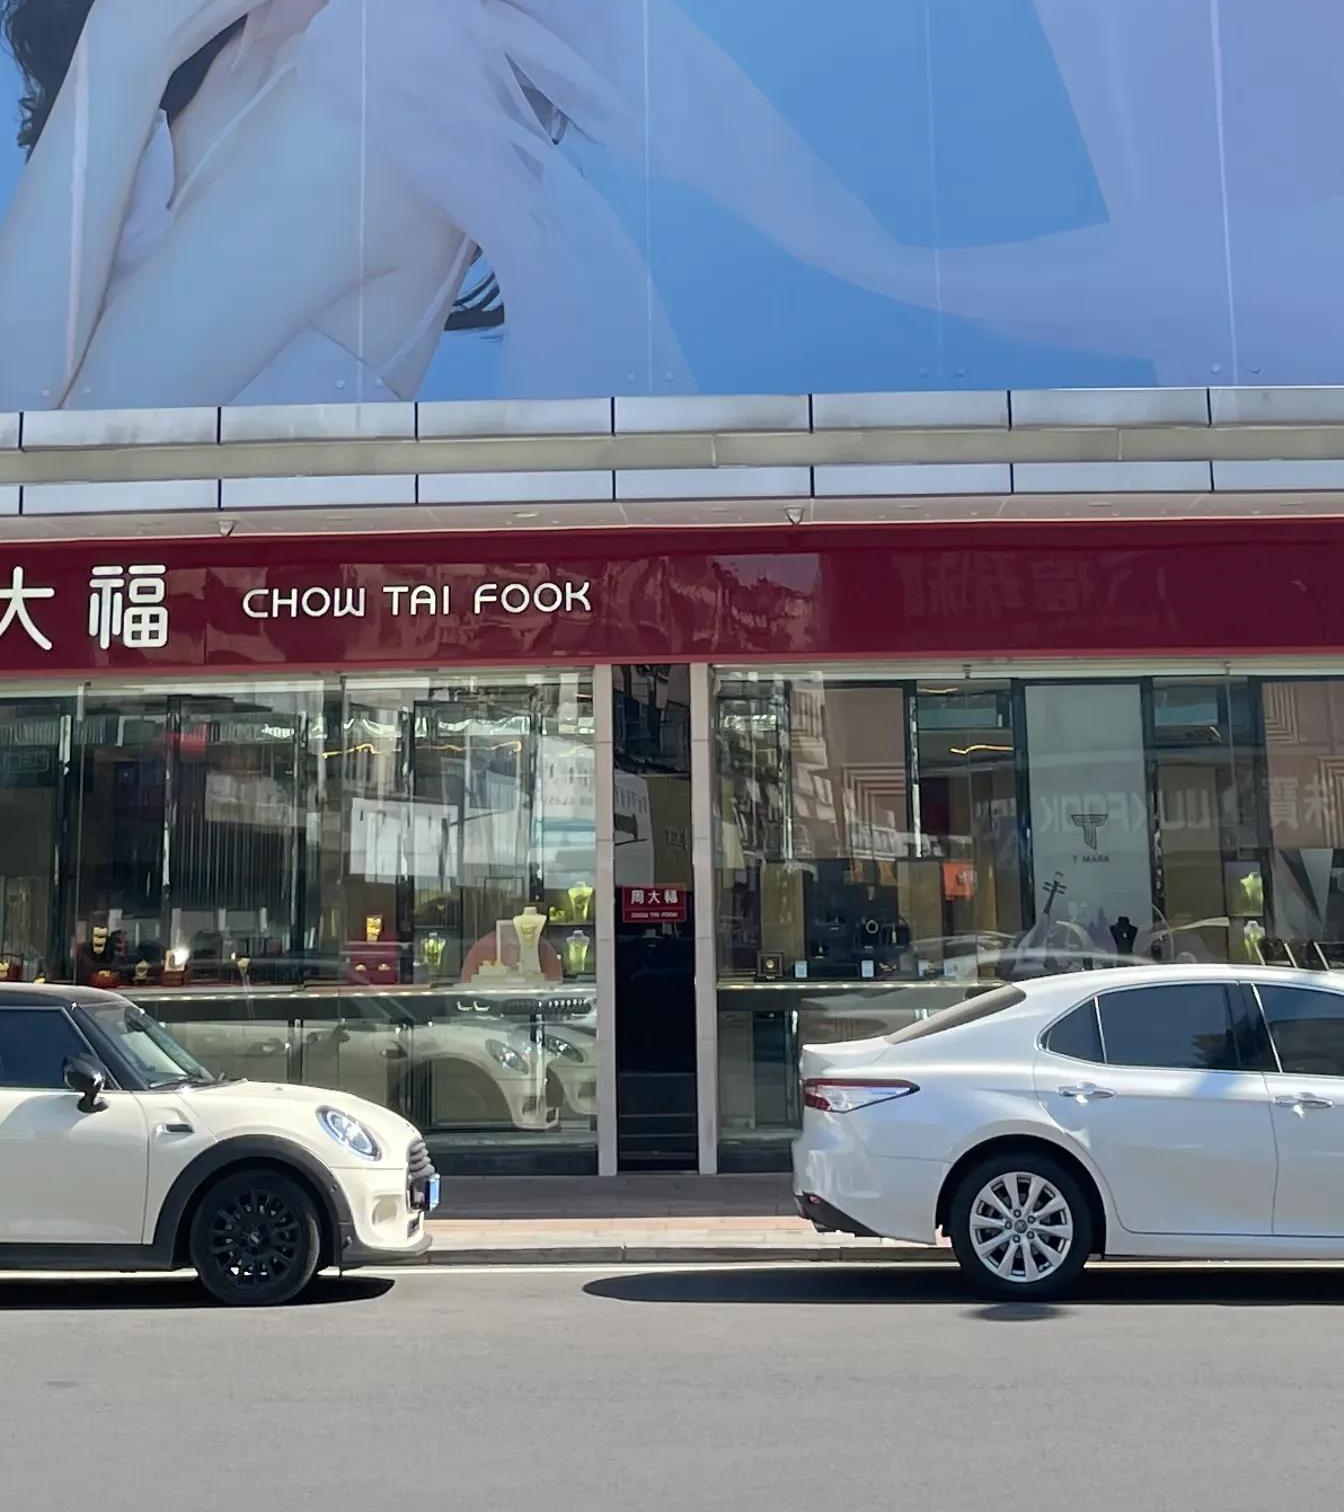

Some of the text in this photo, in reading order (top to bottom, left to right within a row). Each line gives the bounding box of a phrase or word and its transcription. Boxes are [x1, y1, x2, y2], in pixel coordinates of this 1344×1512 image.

[242, 580, 592, 619] CHOW TAI FOOK
